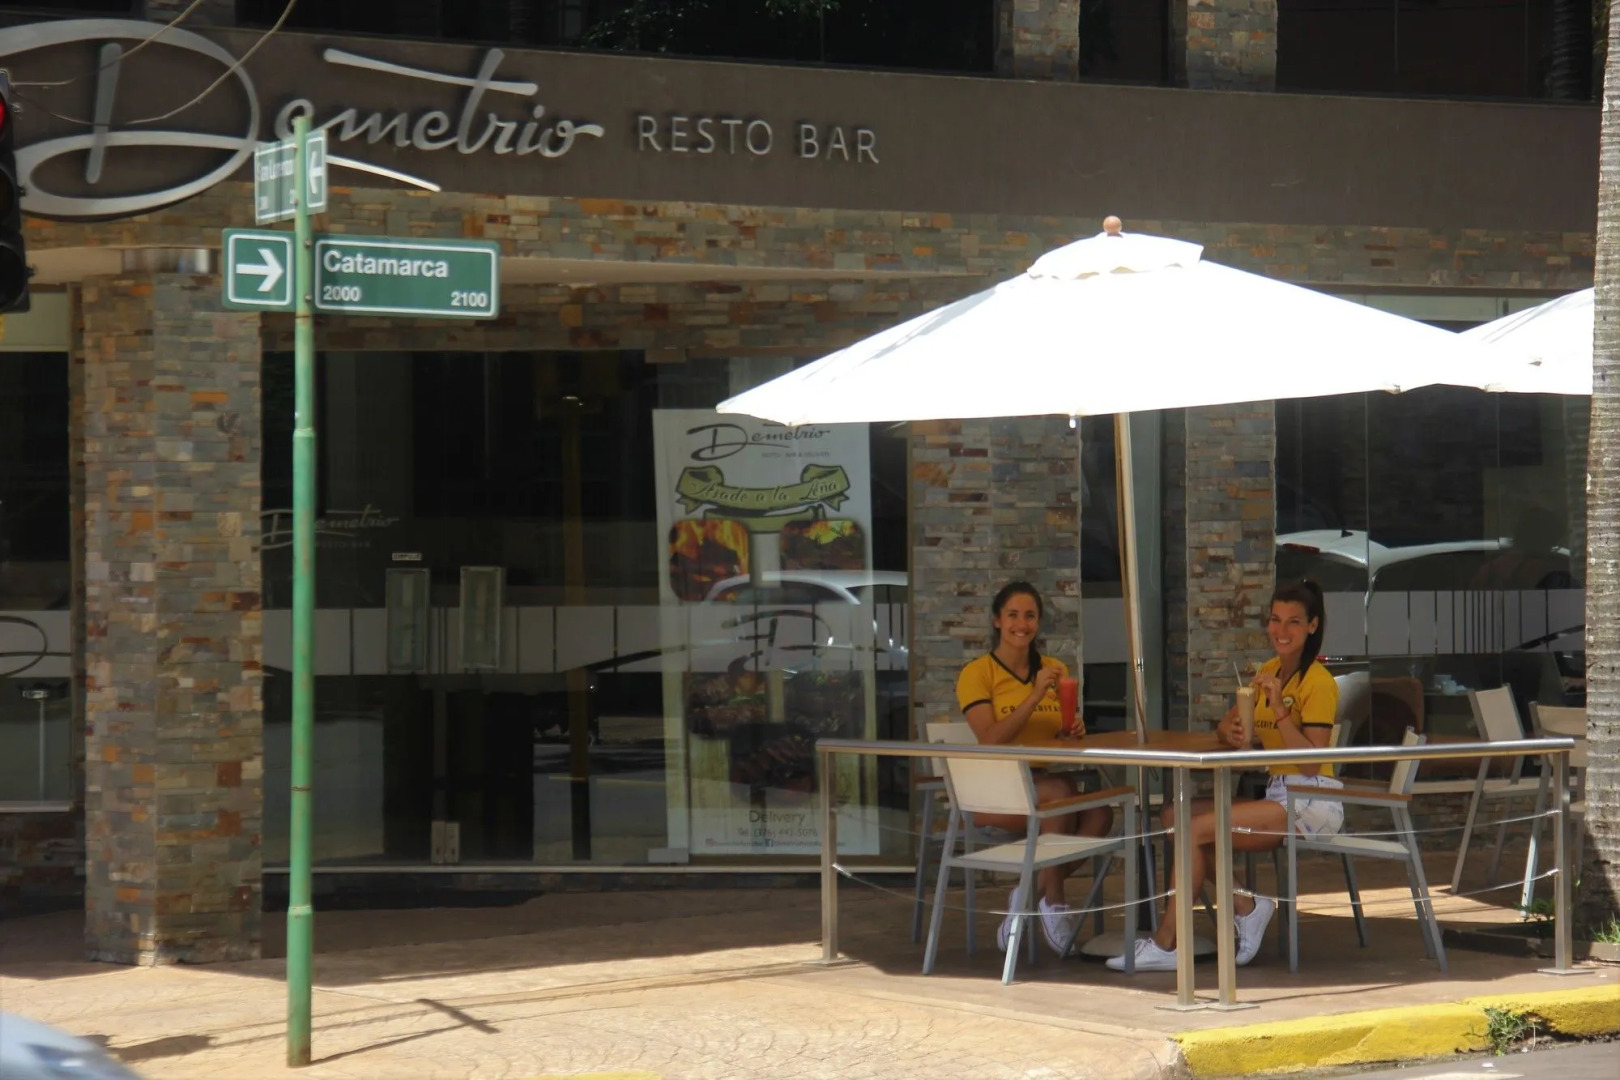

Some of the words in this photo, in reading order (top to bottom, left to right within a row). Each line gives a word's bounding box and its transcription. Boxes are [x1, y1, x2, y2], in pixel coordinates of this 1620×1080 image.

[0, 18, 604, 218] Demetrio
[637, 115, 773, 156] RESTO
[800, 123, 880, 165] BAR
[323, 249, 449, 278] Catamarca
[323, 285, 363, 302] 2000
[450, 291, 488, 308] 2100
[686, 422, 831, 462] Demetrio
[772, 485, 789, 502] la
[748, 810, 806, 827] Delivery
